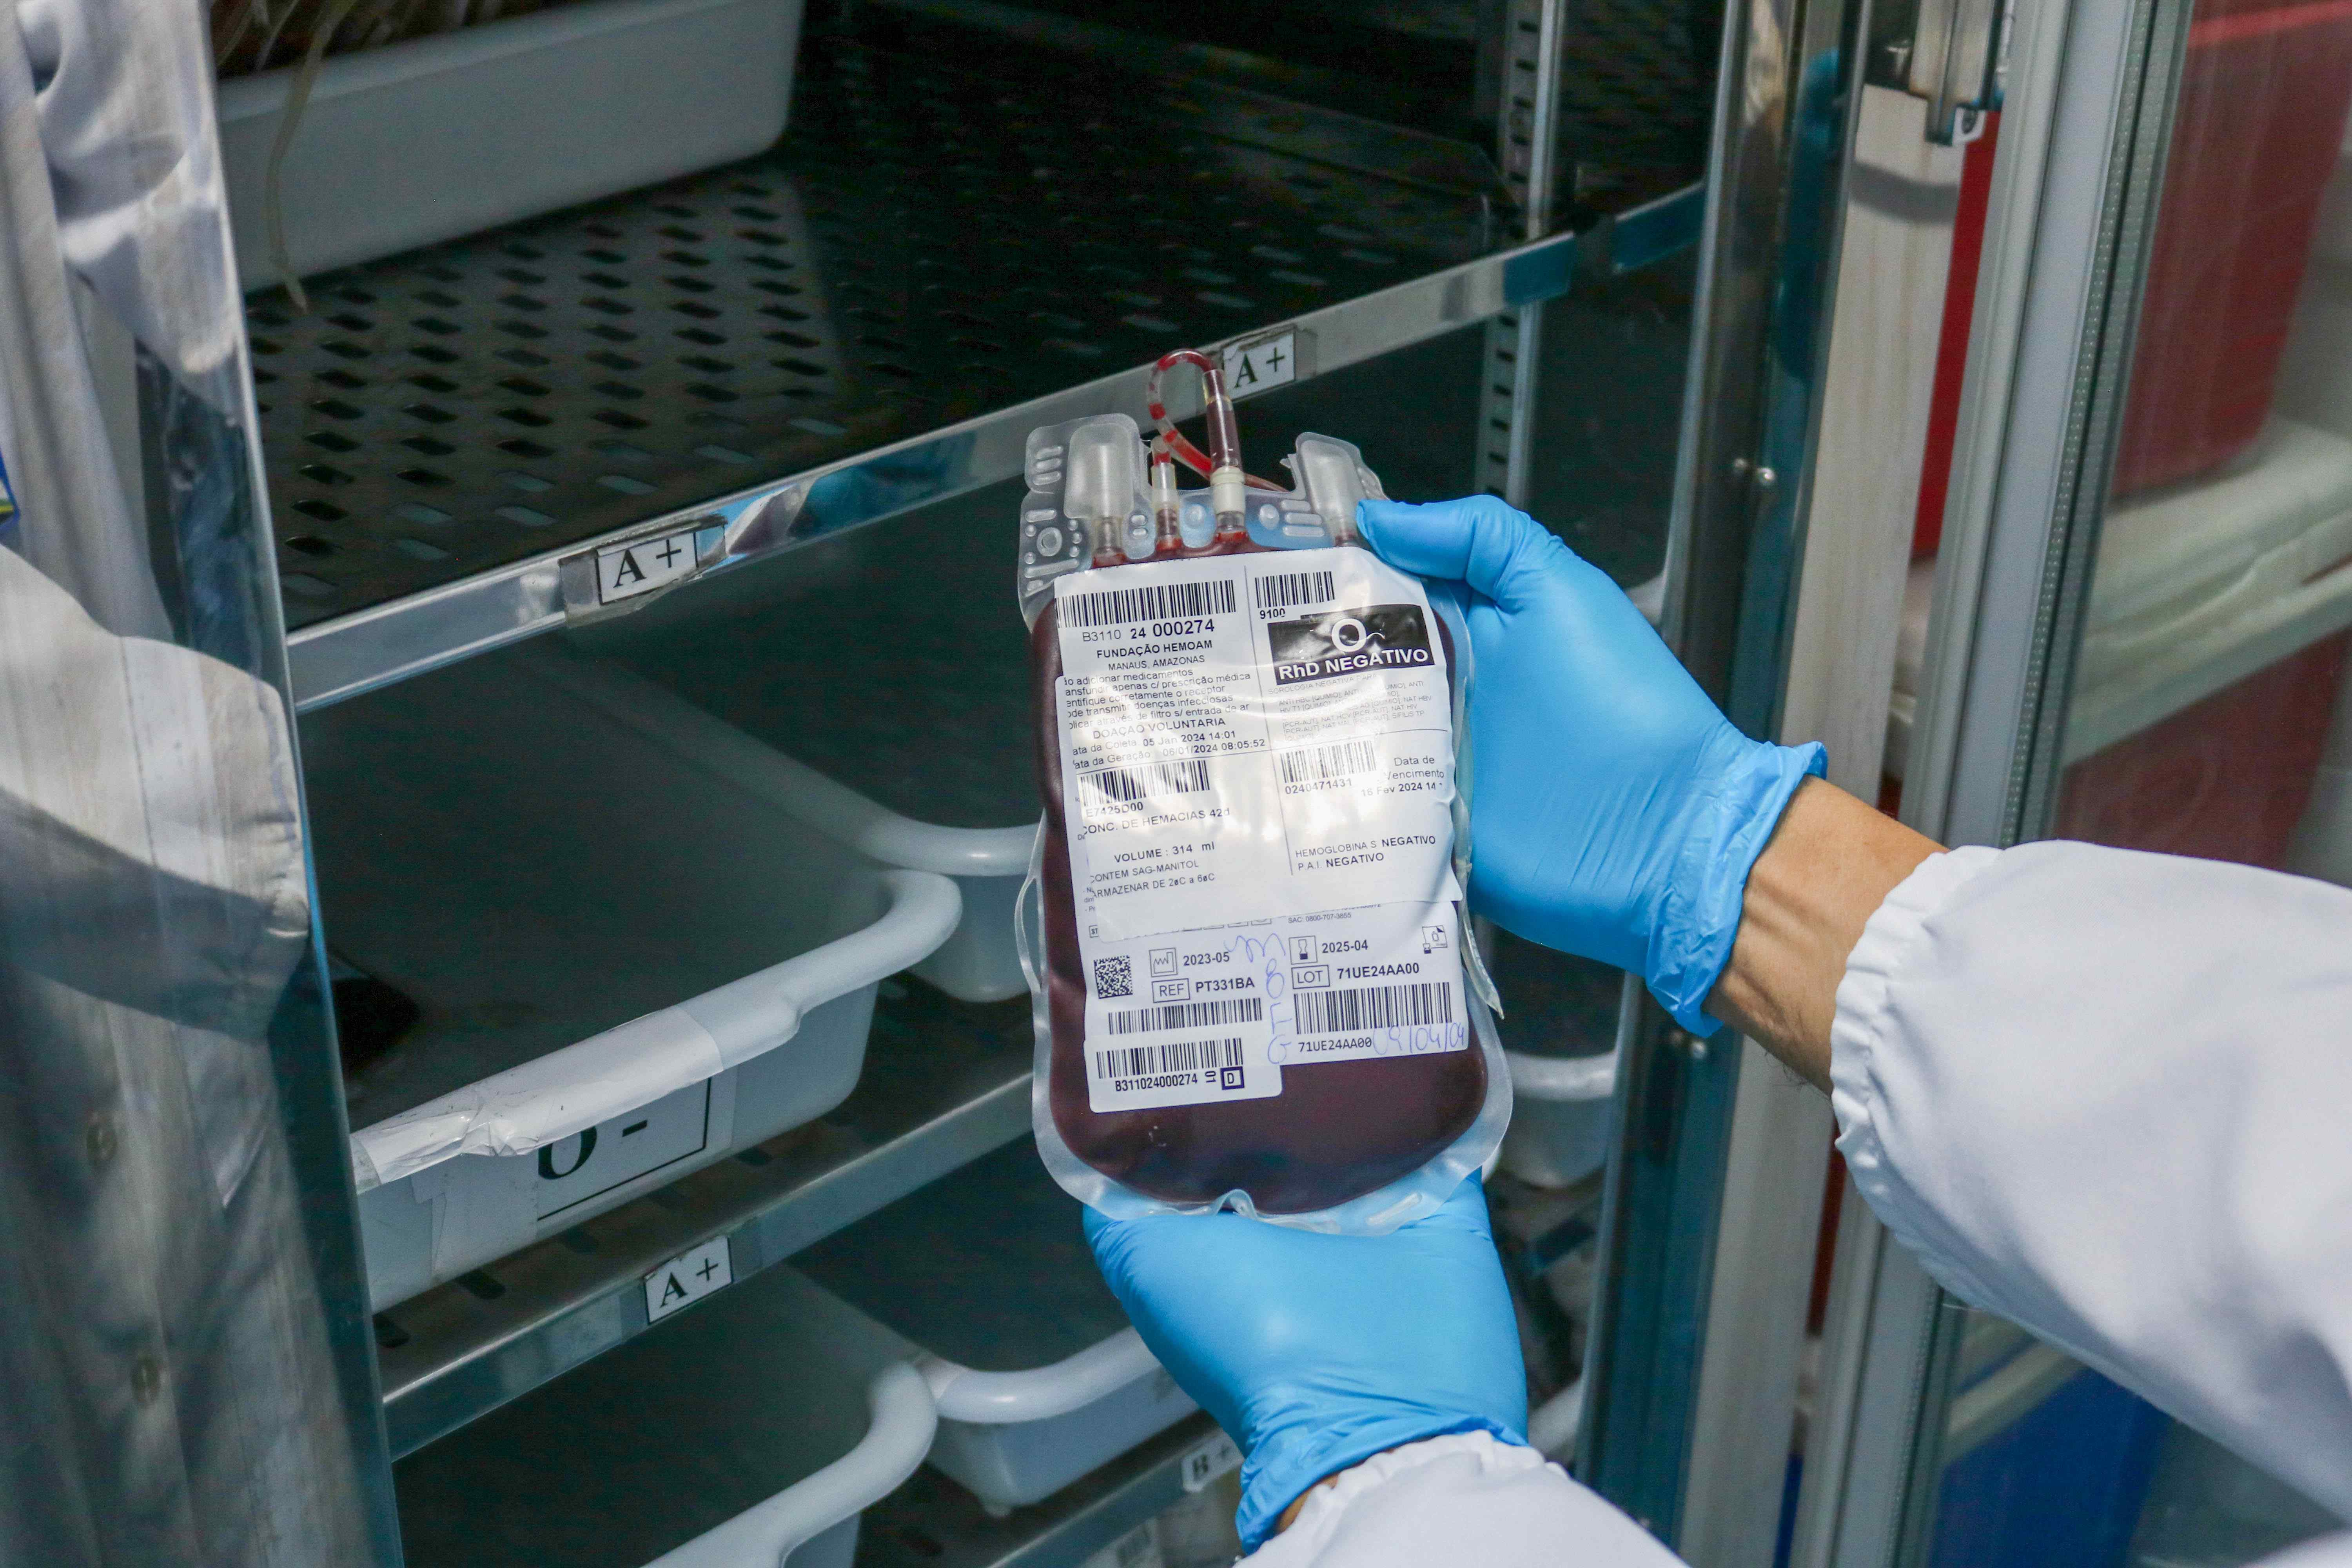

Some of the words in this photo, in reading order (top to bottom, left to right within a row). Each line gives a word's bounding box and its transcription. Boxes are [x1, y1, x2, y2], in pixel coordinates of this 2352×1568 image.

[1259, 608, 1285, 619] 9100
[1082, 629, 1121, 642] B3110
[1131, 627, 1146, 640] 24
[1152, 619, 1215, 637] 000274
[1331, 618, 1367, 652] O
[1097, 644, 1160, 659] FUNDAÇÃO
[1163, 640, 1212, 653] HEMOAM
[1108, 661, 1151, 671] MANAUS,
[1152, 655, 1205, 667] AMAZONAS
[1278, 662, 1320, 680] RhD
[1325, 649, 1428, 673] NEGATIVO
[1076, 675, 1120, 685] adicionar
[1123, 669, 1193, 681] medicamentos
[1112, 682, 1148, 692] apenas
[1161, 676, 1213, 689] prescrição
[1216, 673, 1251, 682] médica
[1268, 683, 1314, 695] SOROLOGIA
[1315, 677, 1354, 688] NEGATIVA
[1109, 691, 1173, 703] corretamente
[1185, 685, 1225, 697] receptor
[1086, 704, 1130, 717] transmitir
[1134, 700, 1175, 710] doenças
[1178, 695, 1233, 706] infecciosas
[1098, 714, 1133, 726] através
[1135, 712, 1147, 720] de
[1151, 710, 1171, 719] filtro
[1185, 706, 1222, 716] entrada
[1147, 718, 1226, 731] VOLUNTARIA
[1091, 744, 1102, 752] da
[1143, 738, 1155, 746] 05
[1158, 737, 1177, 745] Jan
[1181, 733, 1205, 742] 2024
[1209, 731, 1236, 740] 14:01
[1093, 758, 1104, 766] da
[1163, 745, 1218, 757] 06/01/2024
[1221, 739, 1265, 751] 08:05:52
[1394, 757, 1419, 766] Data
[1423, 755, 1435, 764] de
[1285, 778, 1352, 795] 0240471431
[1377, 786, 1395, 795] Fev
[1399, 782, 1423, 792] 2024
[1122, 819, 1139, 829] DE
[1142, 810, 1206, 827] HEMACIAS
[1114, 848, 1163, 863] VOLUME
[1172, 844, 1193, 855] 314
[1201, 841, 1215, 851] ml
[1295, 842, 1368, 858] HEMOGLOBINA
[1370, 840, 1377, 849] S
[1381, 835, 1436, 847] NEGATIVO
[1132, 860, 1199, 876] SAG-MANITOL
[1298, 861, 1322, 871] P.A.I.
[1326, 852, 1385, 868] NEGATIVO
[1152, 879, 1166, 889] DE
[1305, 912, 1352, 922] 0800-707-3855
[1321, 939, 1368, 954] 2025-04
[1183, 952, 1230, 966] 2023-05
[1296, 969, 1323, 984] LOT
[1337, 962, 1420, 980] 71UE24AA00
[1159, 983, 1185, 997] REF
[1195, 976, 1256, 993] PT331BA
[1298, 1037, 1372, 1053] 71UE24AA00
[1115, 1073, 1198, 1092] B311024000274
